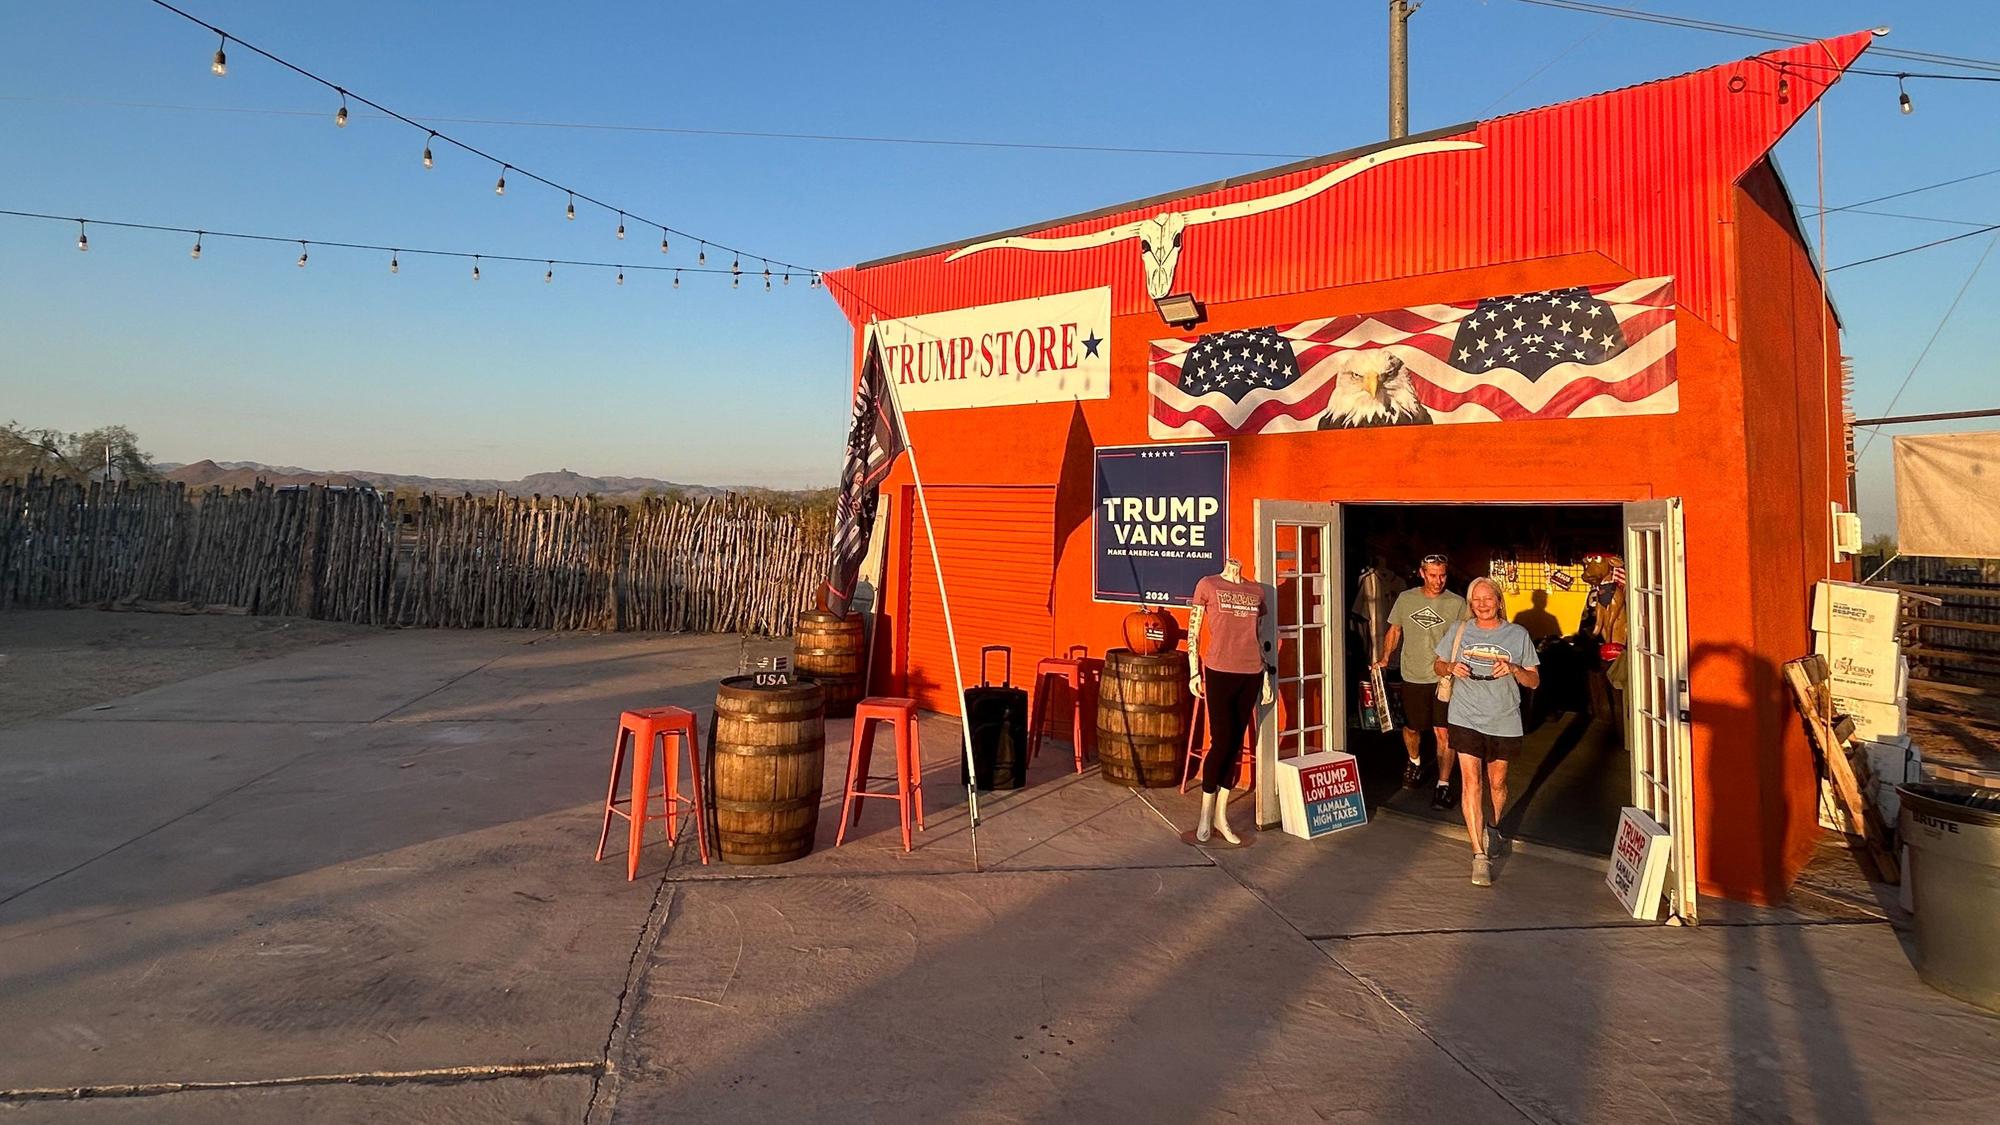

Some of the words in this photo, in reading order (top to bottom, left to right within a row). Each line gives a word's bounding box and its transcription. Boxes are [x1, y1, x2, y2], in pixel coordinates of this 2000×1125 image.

[885, 336, 974, 385] TRUMP
[980, 323, 1078, 377] STORE
[1103, 496, 1219, 523] TRUMP
[1113, 524, 1205, 547] VANCE
[1107, 548, 1127, 557] MAKE
[1128, 549, 1160, 558] AMERICA
[1160, 550, 1185, 559] GREAT
[1145, 591, 1170, 601] 2024
[1832, 608, 1867, 618] RESPECT
[756, 673, 788, 686] USA
[1309, 768, 1348, 788] TRUMP
[1306, 788, 1327, 802] LOW
[1328, 781, 1356, 798] TAXES
[1312, 813, 1333, 827] HIGH
[1333, 806, 1358, 821] TAXES
[1317, 798, 1351, 815] KAMALA
[1622, 820, 1646, 853] TRUMP
[1617, 836, 1643, 870] SAFETY
